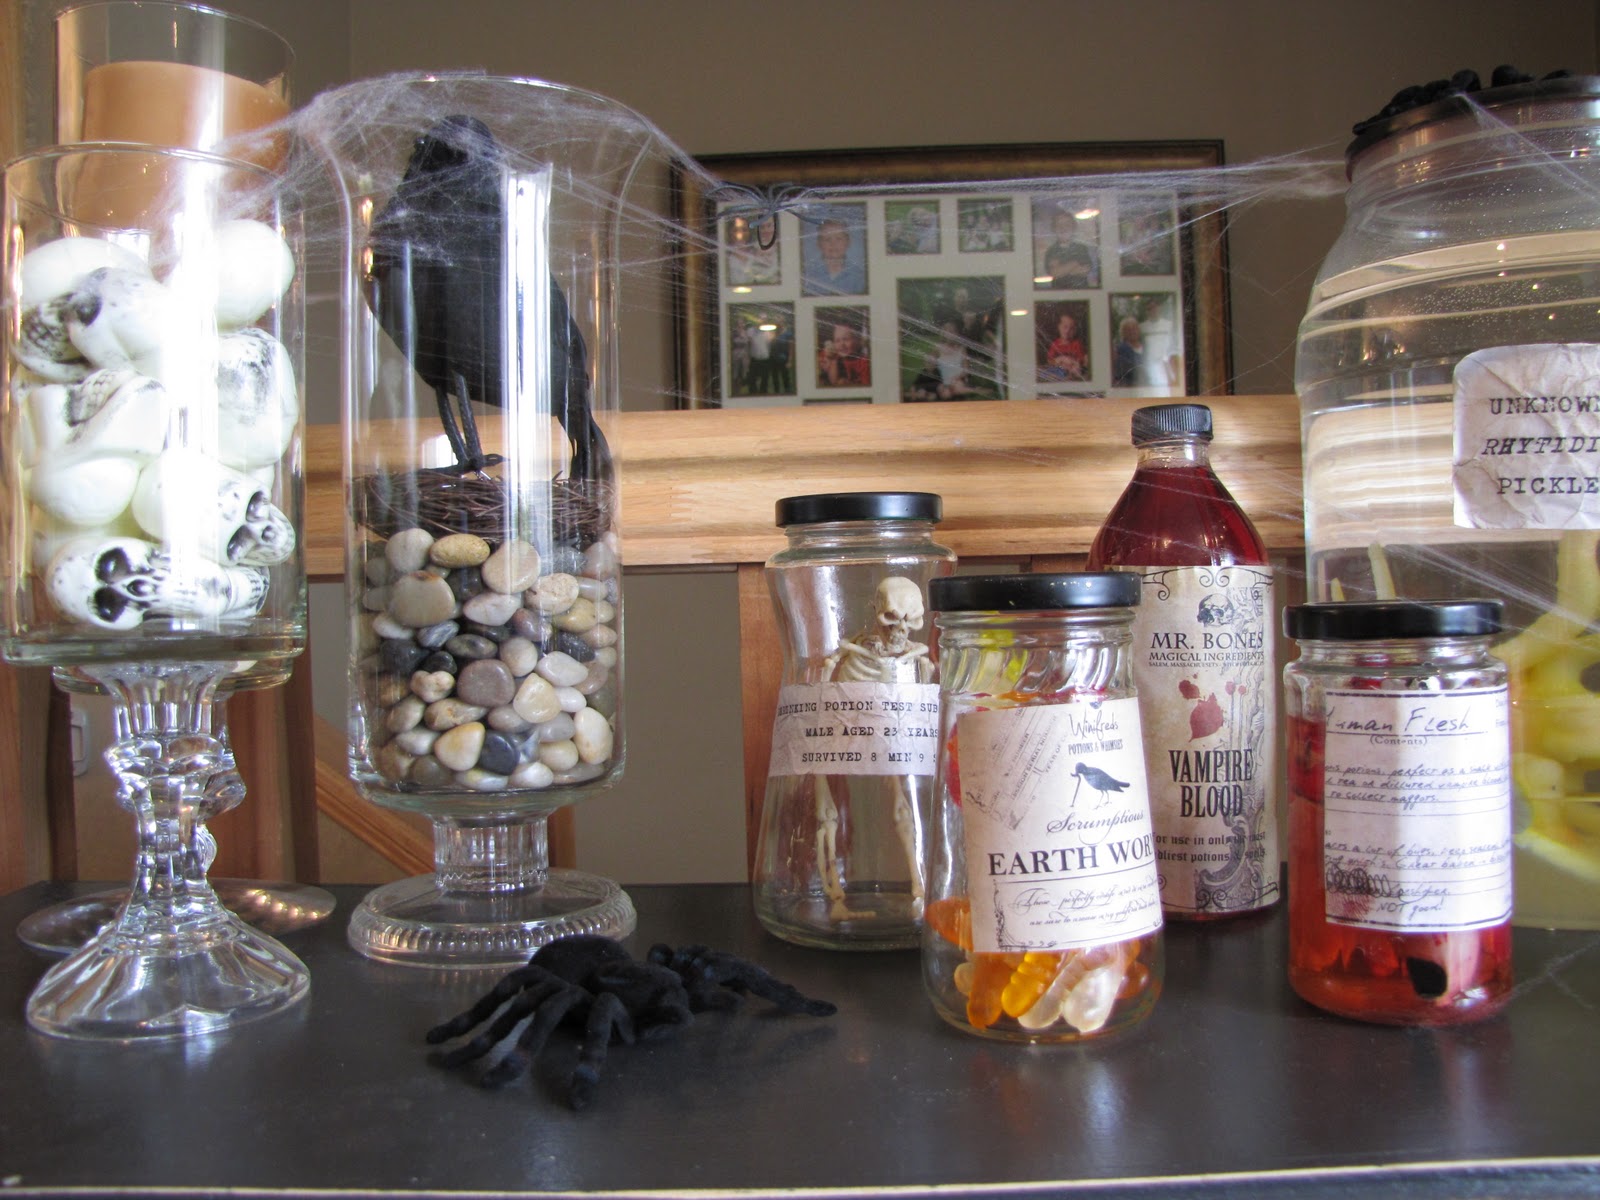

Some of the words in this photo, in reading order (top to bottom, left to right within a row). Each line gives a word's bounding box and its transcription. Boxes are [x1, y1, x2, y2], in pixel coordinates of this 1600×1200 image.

[1496, 477, 1600, 494] PICKLE
[1151, 632, 1194, 650] MR.
[1203, 631, 1263, 649] BONES
[1149, 652, 1201, 661] MAGICAL
[1204, 651, 1264, 661] INGREDIENTS
[824, 700, 874, 712] POTION
[881, 700, 913, 712] TEST
[1404, 705, 1471, 733] Flesh
[805, 727, 834, 738] MALE
[842, 726, 875, 737] AGED
[883, 726, 898, 737] 23
[801, 751, 862, 763] SURVIVED
[870, 751, 877, 762] 8
[887, 752, 912, 763] MIN
[918, 752, 925, 763] 9
[1168, 749, 1252, 783] VAMPIRE
[1180, 785, 1243, 818] BLOOD
[1046, 810, 1145, 846] Scrumptious
[1171, 836, 1189, 845] use
[1193, 836, 1204, 845] in
[988, 844, 1099, 876] EARTH
[1106, 832, 1154, 867] WOR
[1190, 851, 1230, 864] potions
